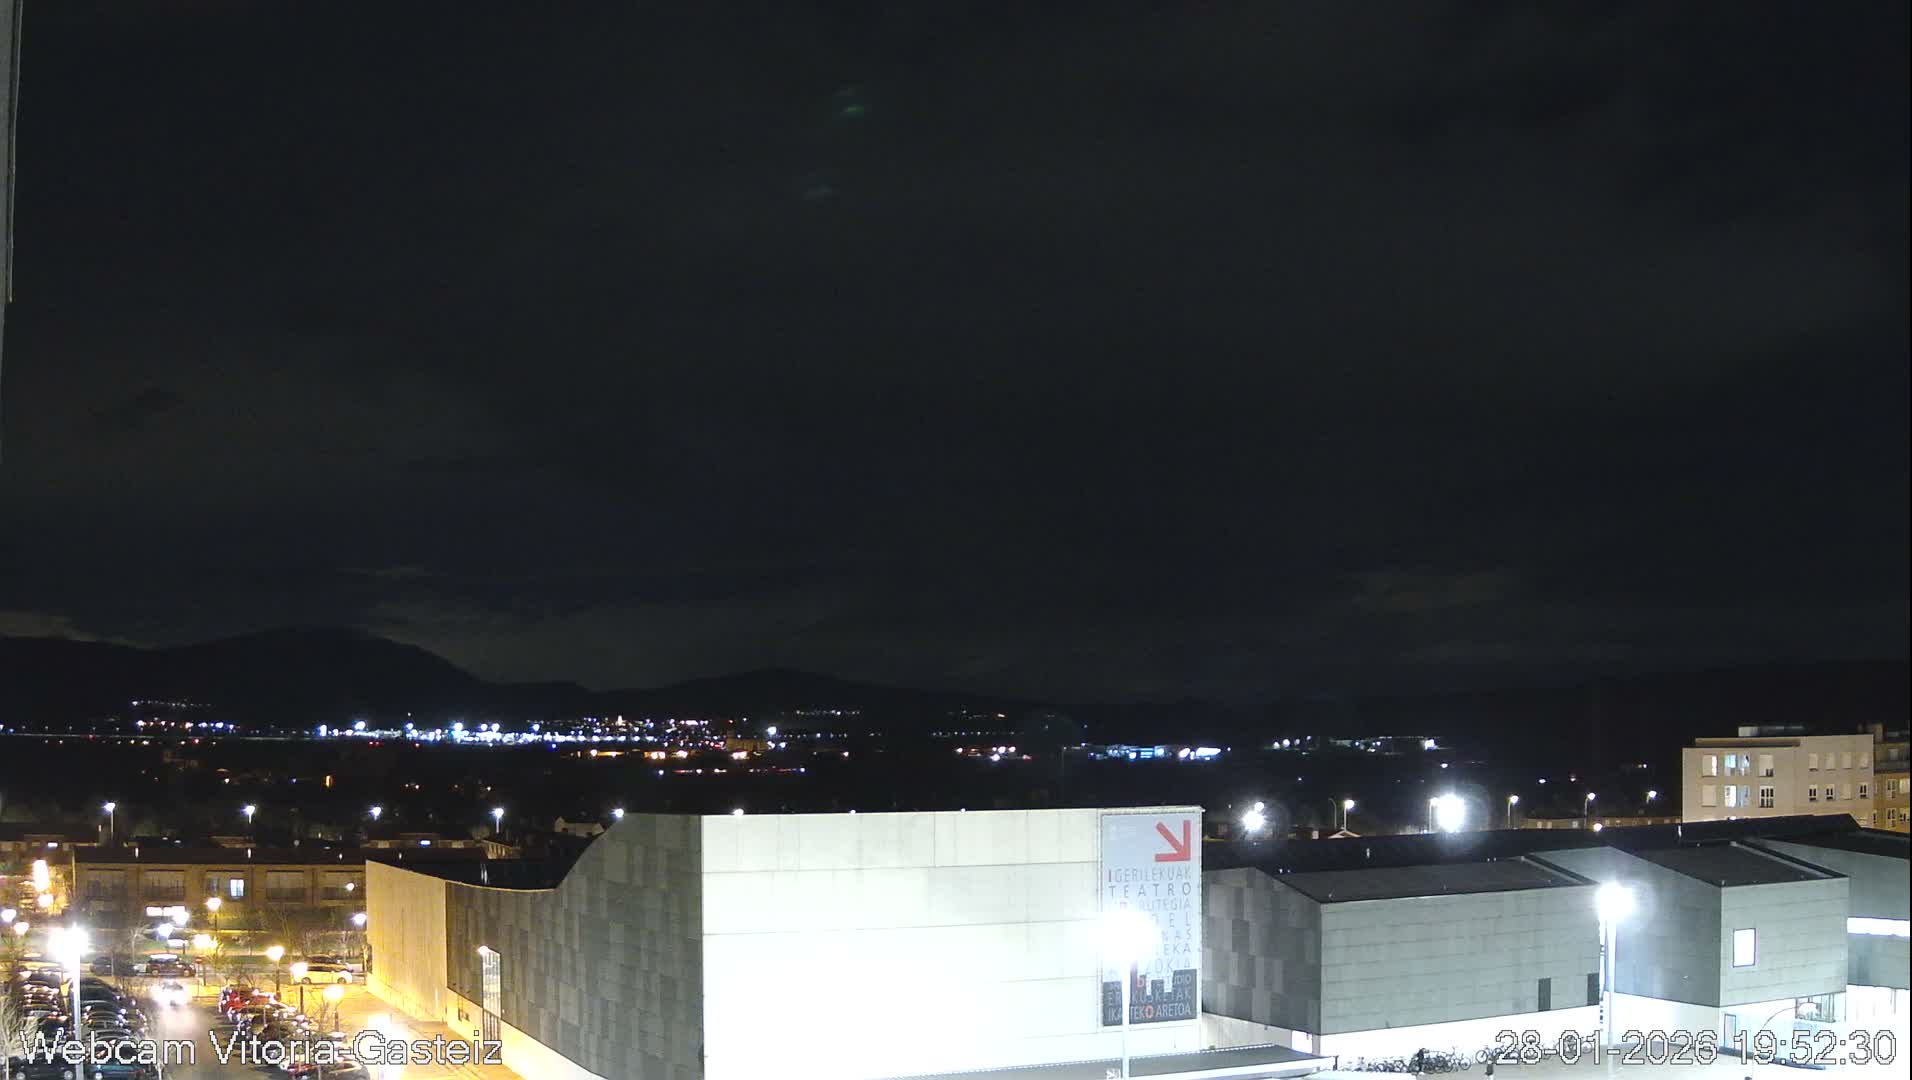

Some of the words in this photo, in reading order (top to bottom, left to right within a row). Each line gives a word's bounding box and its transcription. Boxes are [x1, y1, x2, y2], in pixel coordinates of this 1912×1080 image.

[1108, 867, 1192, 883] IGERILEKUAK
[1108, 882, 1192, 898] TEATRO
[1108, 1004, 1154, 1022] IKATEKO
[1155, 1001, 1192, 1017] ARETOA
